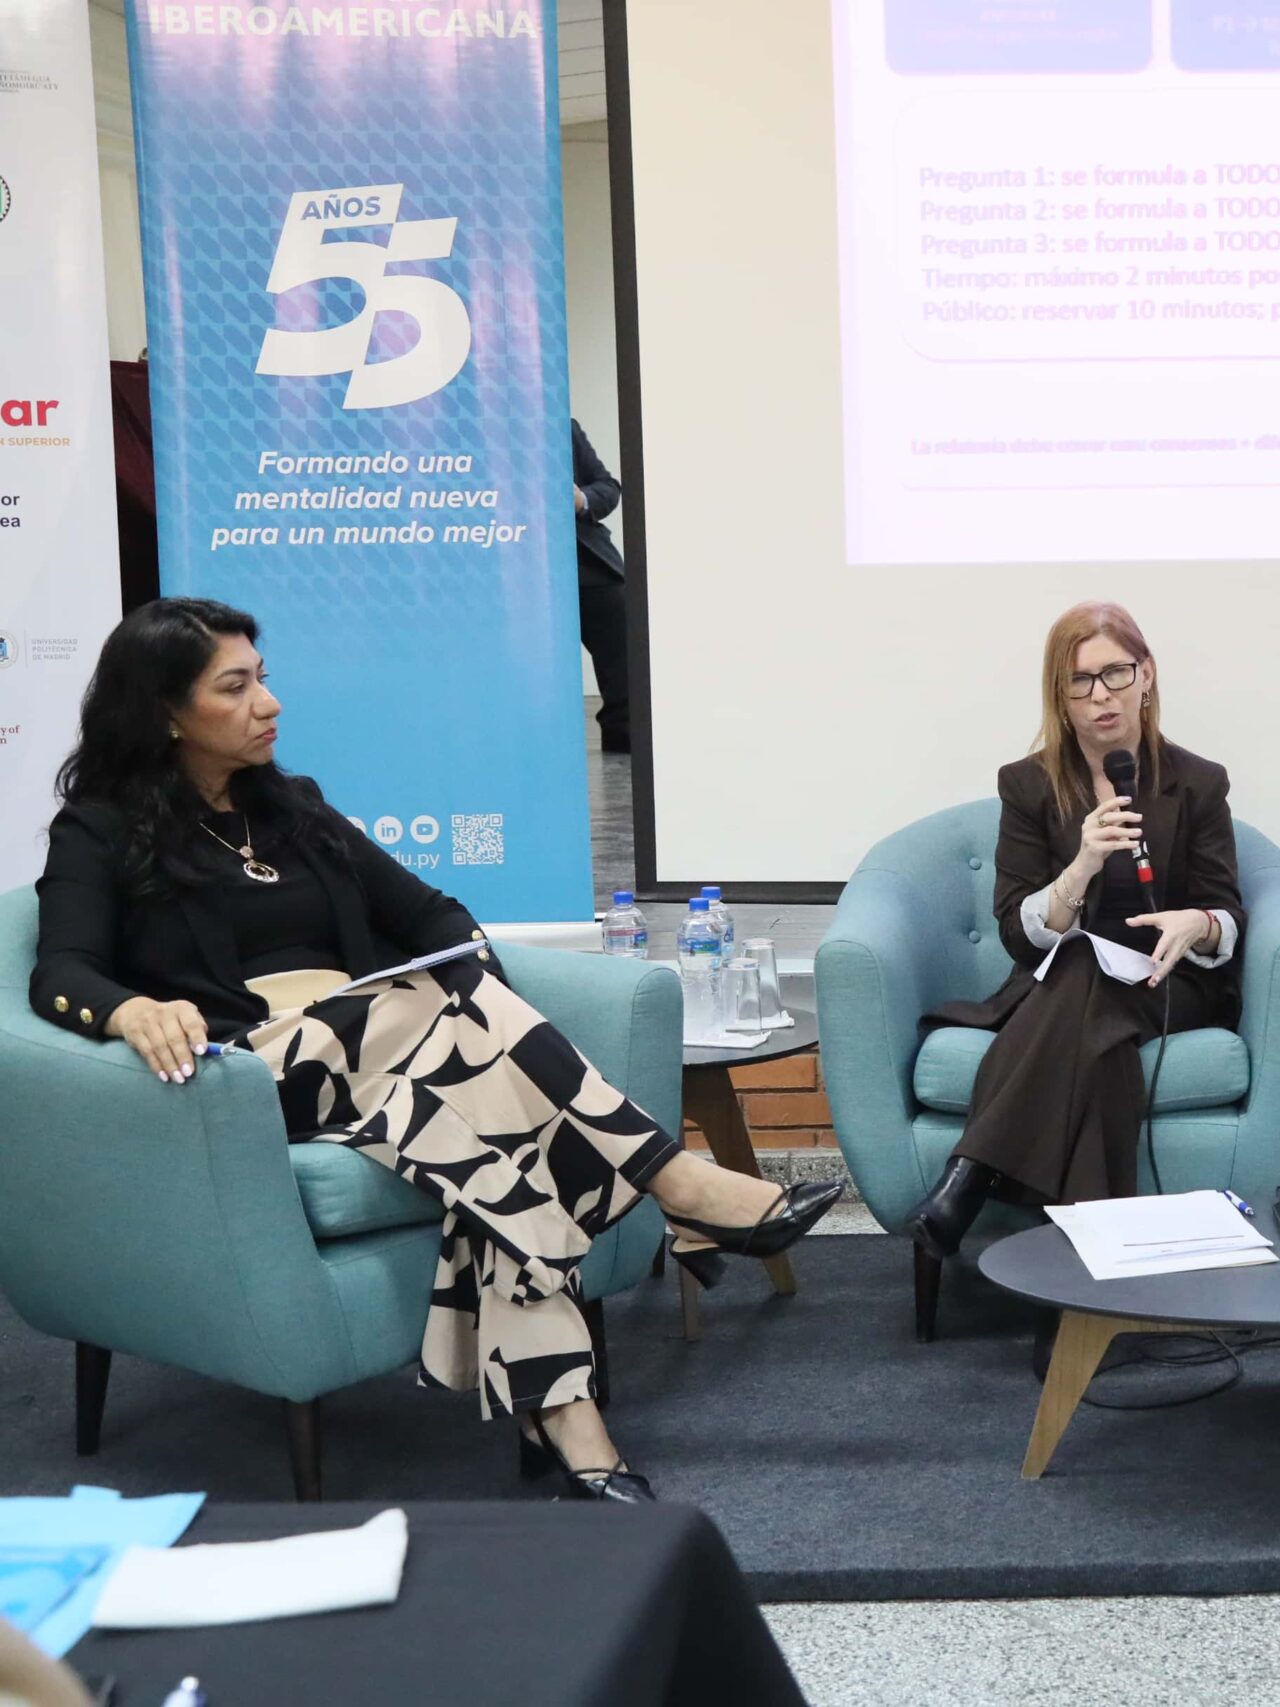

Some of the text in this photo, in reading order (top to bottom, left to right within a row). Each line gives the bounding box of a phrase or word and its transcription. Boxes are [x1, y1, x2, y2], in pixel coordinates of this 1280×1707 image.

[148, 4, 538, 38] IBEROAMERICANA
[920, 167, 1026, 192] Pregunta
[1034, 166, 1055, 187] 1:
[1061, 169, 1088, 186] se
[1093, 163, 1188, 186] formula
[1193, 168, 1207, 185] a
[300, 194, 381, 220] AÑOS
[921, 200, 1026, 225] Pregunta
[1034, 200, 1055, 220] 2:
[1062, 204, 1088, 220] se
[1095, 197, 1187, 219] formula
[1193, 203, 1207, 219] a
[921, 234, 1027, 259] Pregunta
[1034, 233, 1055, 255] 3:
[1062, 238, 1089, 253] se
[1095, 230, 1188, 254] formula
[1193, 236, 1207, 252] a
[922, 268, 1017, 291] Tiempo:
[1024, 266, 1119, 287] máximo
[1126, 266, 1139, 287] 2
[1146, 266, 1243, 285] minutos
[255, 183, 472, 410] 55
[923, 301, 1016, 322] Público:
[1021, 304, 1119, 321] reservar
[1128, 299, 1156, 320] 10
[1162, 299, 1265, 320] minutos;
[8, 437, 71, 447] SUPERIOR
[258, 450, 472, 475] Formando una
[234, 486, 498, 510] mentalidad nueva
[211, 520, 527, 551] para un mundo mejor
